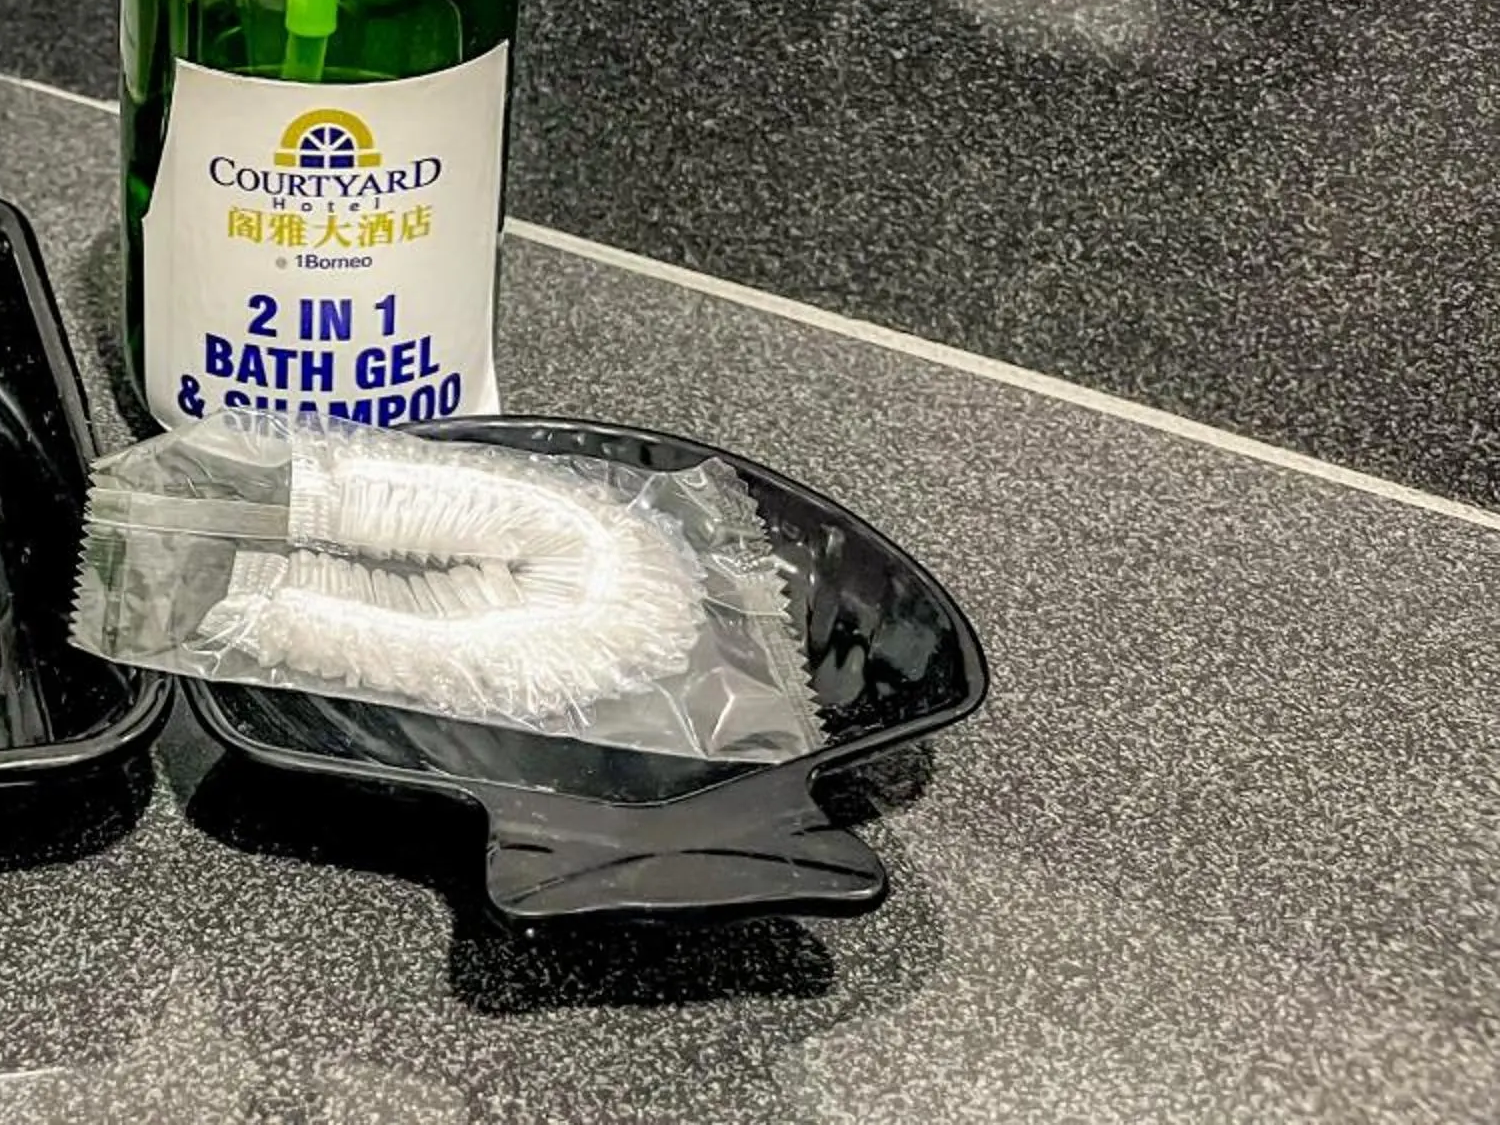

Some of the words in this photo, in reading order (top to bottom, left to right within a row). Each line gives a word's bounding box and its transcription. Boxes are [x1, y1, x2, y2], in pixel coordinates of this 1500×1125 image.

[272, 197, 381, 213] Hotel
[295, 254, 373, 270] 1Borneo
[247, 294, 278, 338] 2
[300, 299, 352, 341] IN
[375, 293, 396, 337] 1
[205, 332, 334, 392] BATH
[355, 335, 440, 390] GEL
[177, 373, 205, 420] &
